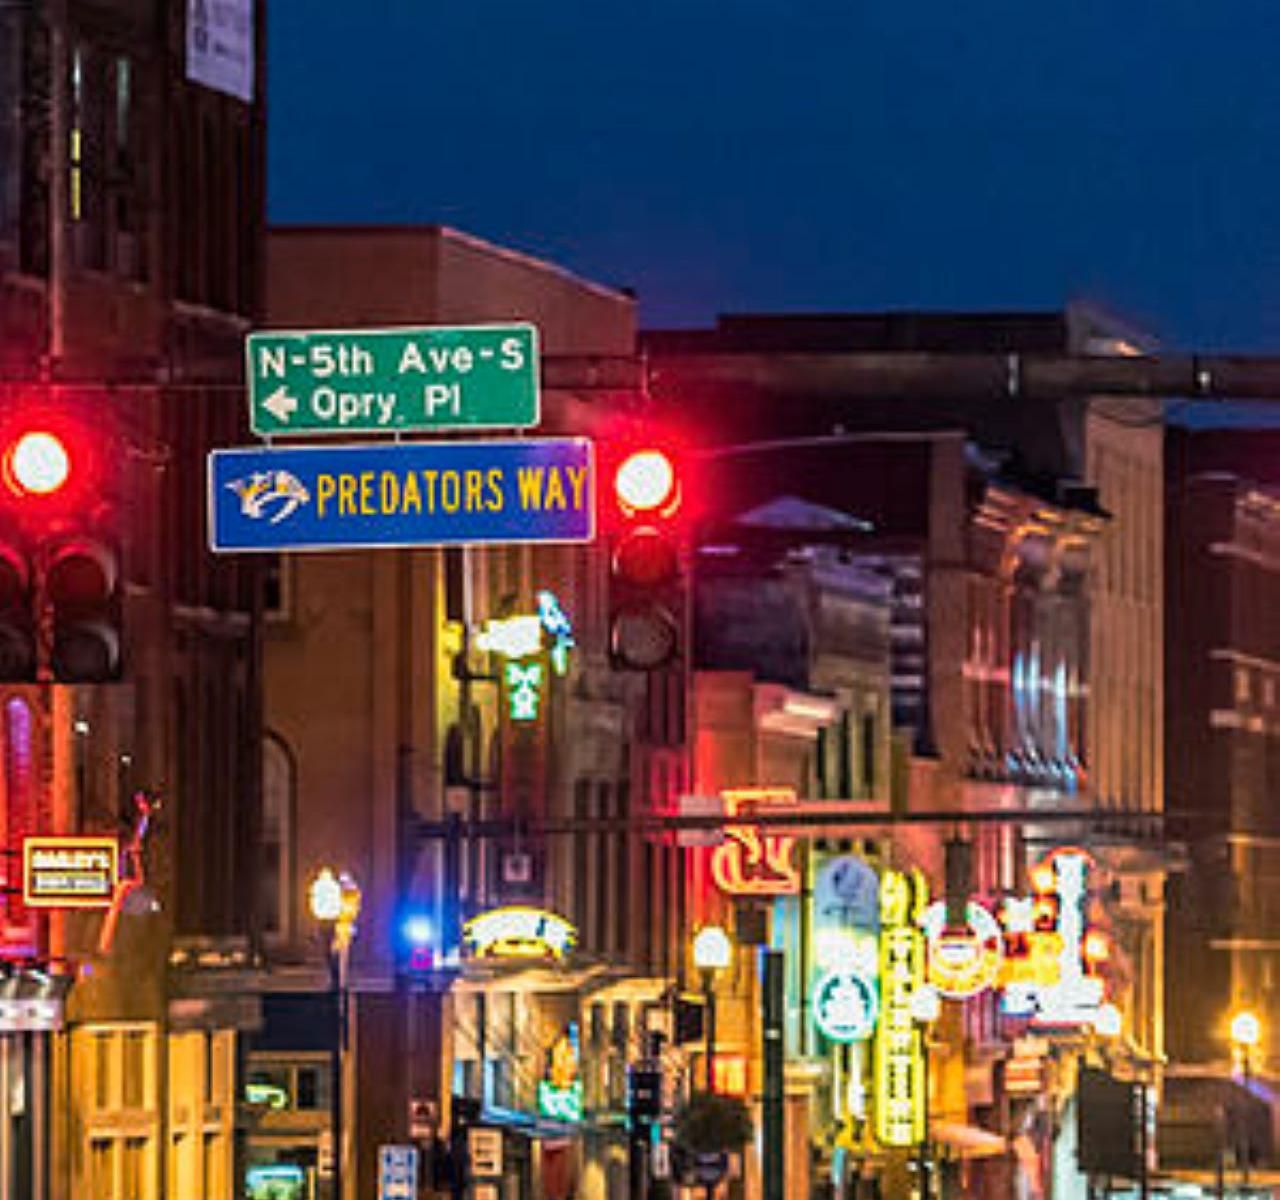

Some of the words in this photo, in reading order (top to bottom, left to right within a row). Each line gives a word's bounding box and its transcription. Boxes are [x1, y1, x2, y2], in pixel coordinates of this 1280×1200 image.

[310, 385, 397, 425] Opry
[422, 383, 463, 418] Pl
[316, 469, 505, 520] PREDATORS
[517, 464, 588, 511] WAY
